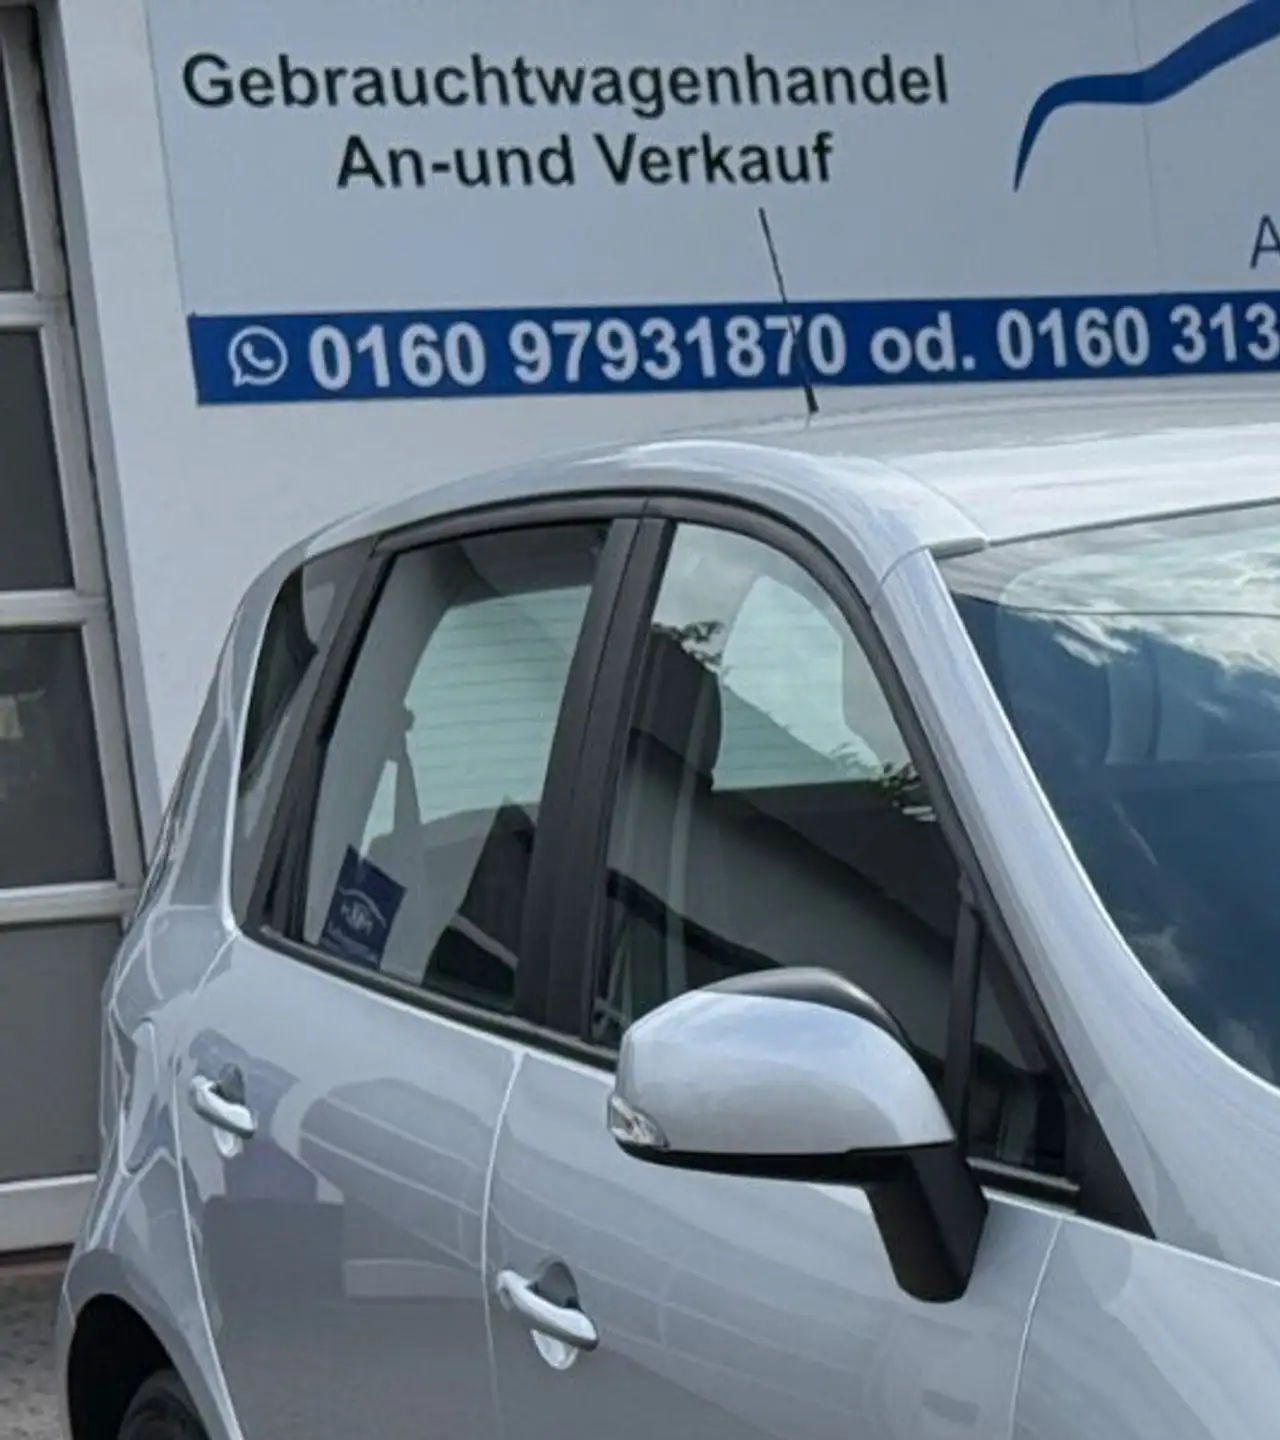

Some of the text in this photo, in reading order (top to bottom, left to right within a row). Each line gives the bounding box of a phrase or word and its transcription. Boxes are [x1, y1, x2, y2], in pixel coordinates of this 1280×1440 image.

[182, 53, 949, 118] Gebrauchtwagenhandel
[336, 131, 835, 191] An-und Verkauf
[309, 321, 487, 391] 0160
[507, 313, 848, 386] 97931870
[869, 312, 978, 372] od.
[994, 306, 1150, 372] 0160
